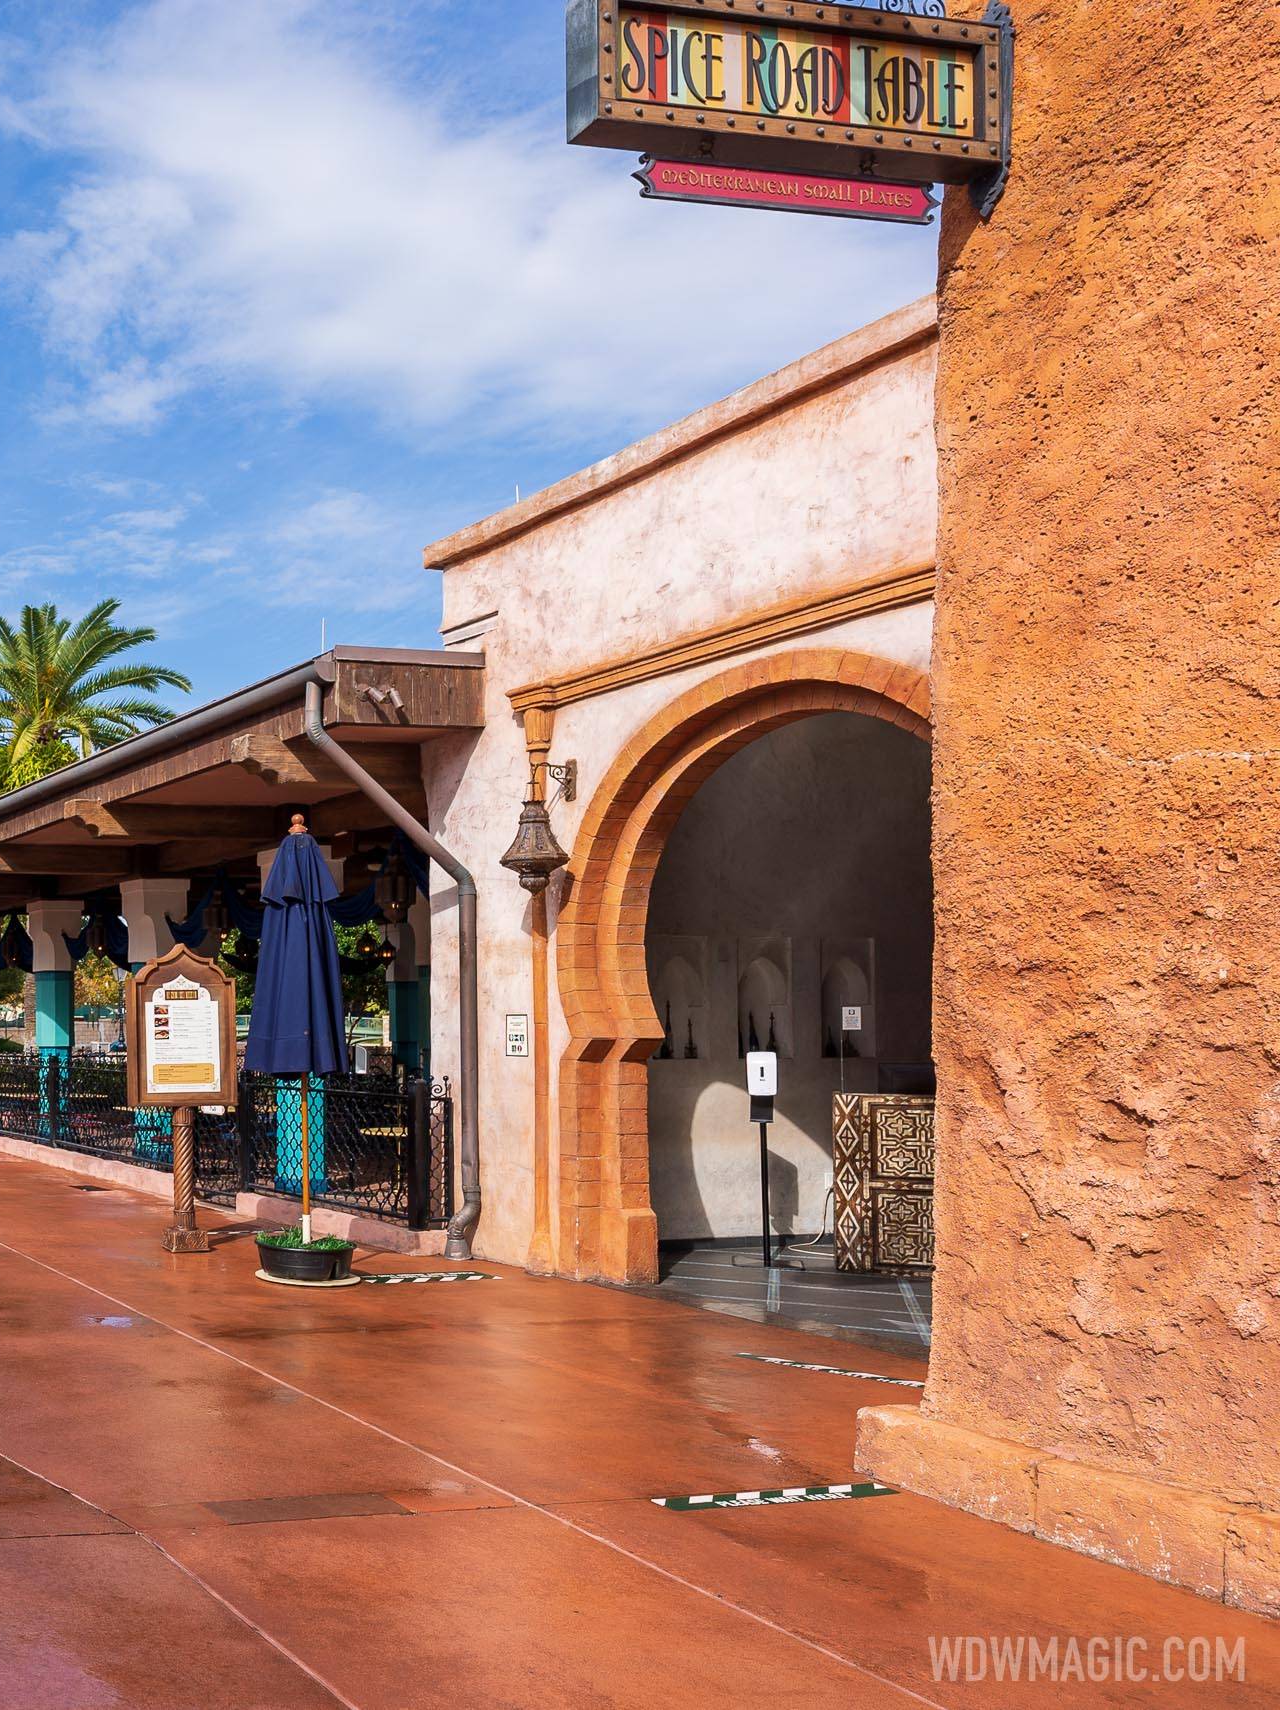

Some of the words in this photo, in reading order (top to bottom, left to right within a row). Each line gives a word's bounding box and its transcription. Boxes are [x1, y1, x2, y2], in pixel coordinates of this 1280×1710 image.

[622, 16, 726, 105] SPICE
[745, 31, 845, 114] ROAD
[857, 45, 967, 128] TABLE
[662, 168, 799, 196] MEDITERRANEAN
